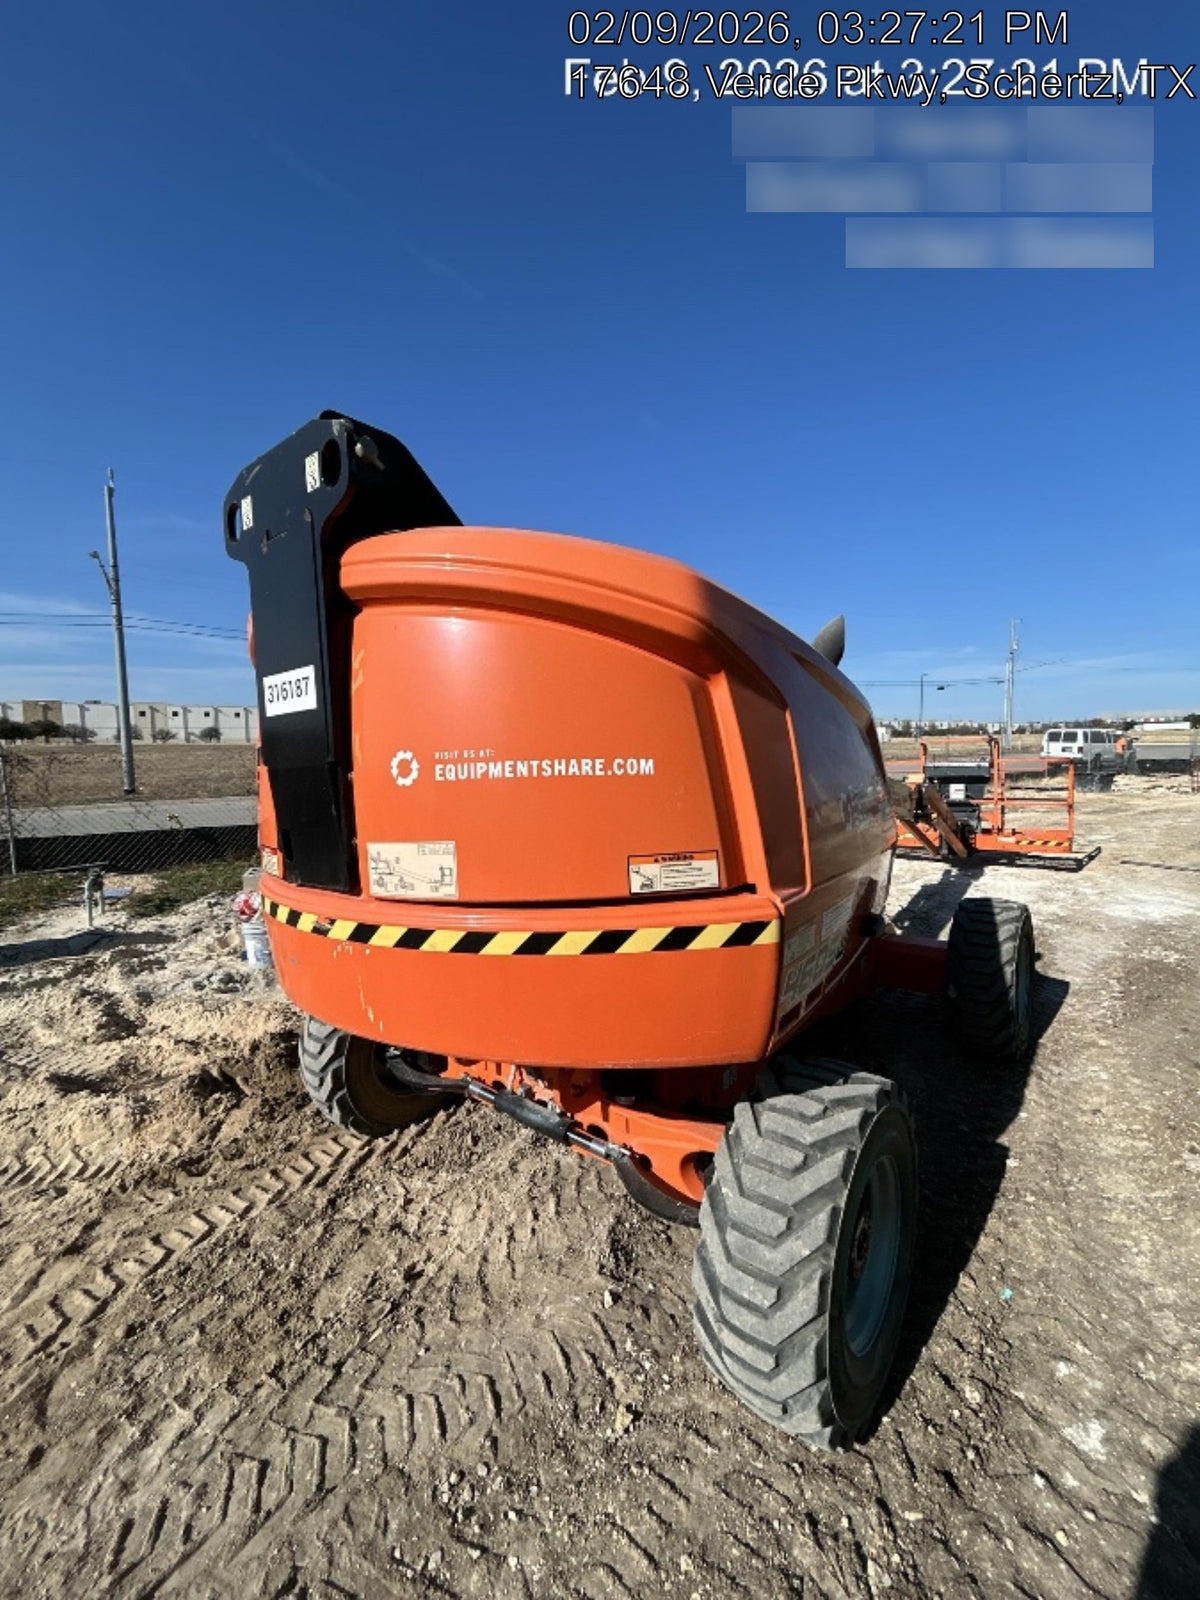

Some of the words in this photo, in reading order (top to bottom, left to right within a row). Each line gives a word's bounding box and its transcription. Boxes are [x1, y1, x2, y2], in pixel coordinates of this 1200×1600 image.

[267, 676, 310, 703] 316187
[433, 750, 459, 760] VISIT
[463, 749, 475, 759] US
[434, 758, 655, 781] EQUIPMENTSHARE.COM
